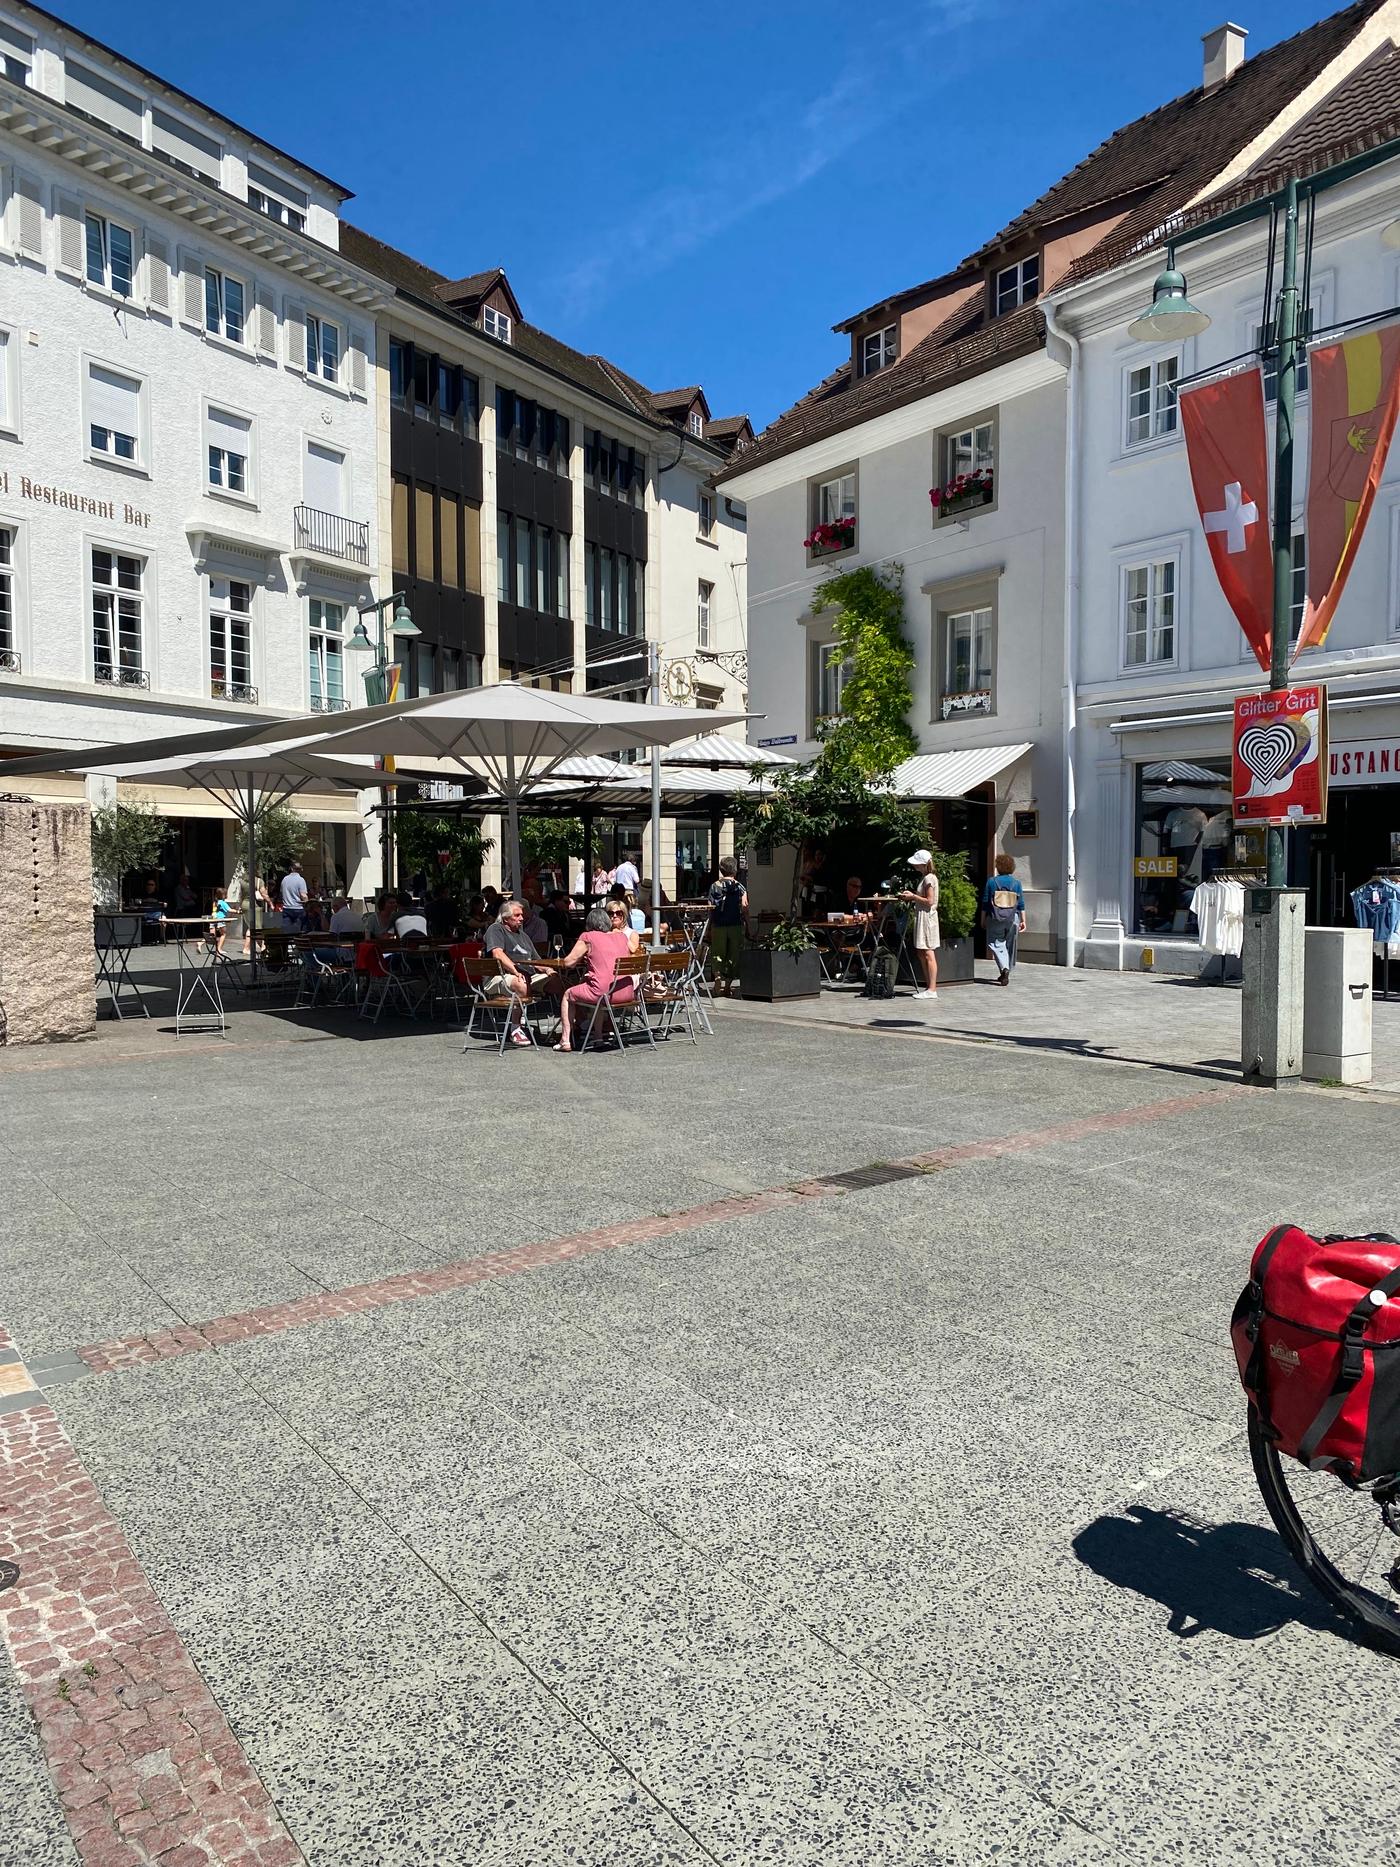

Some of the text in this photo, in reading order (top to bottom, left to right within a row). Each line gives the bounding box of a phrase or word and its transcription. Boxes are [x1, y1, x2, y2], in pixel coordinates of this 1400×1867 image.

[20, 475, 115, 520] Restaurant
[123, 503, 151, 529] Bar
[1239, 693, 1316, 717] Glitter Grit
[1138, 860, 1174, 873] SALE
